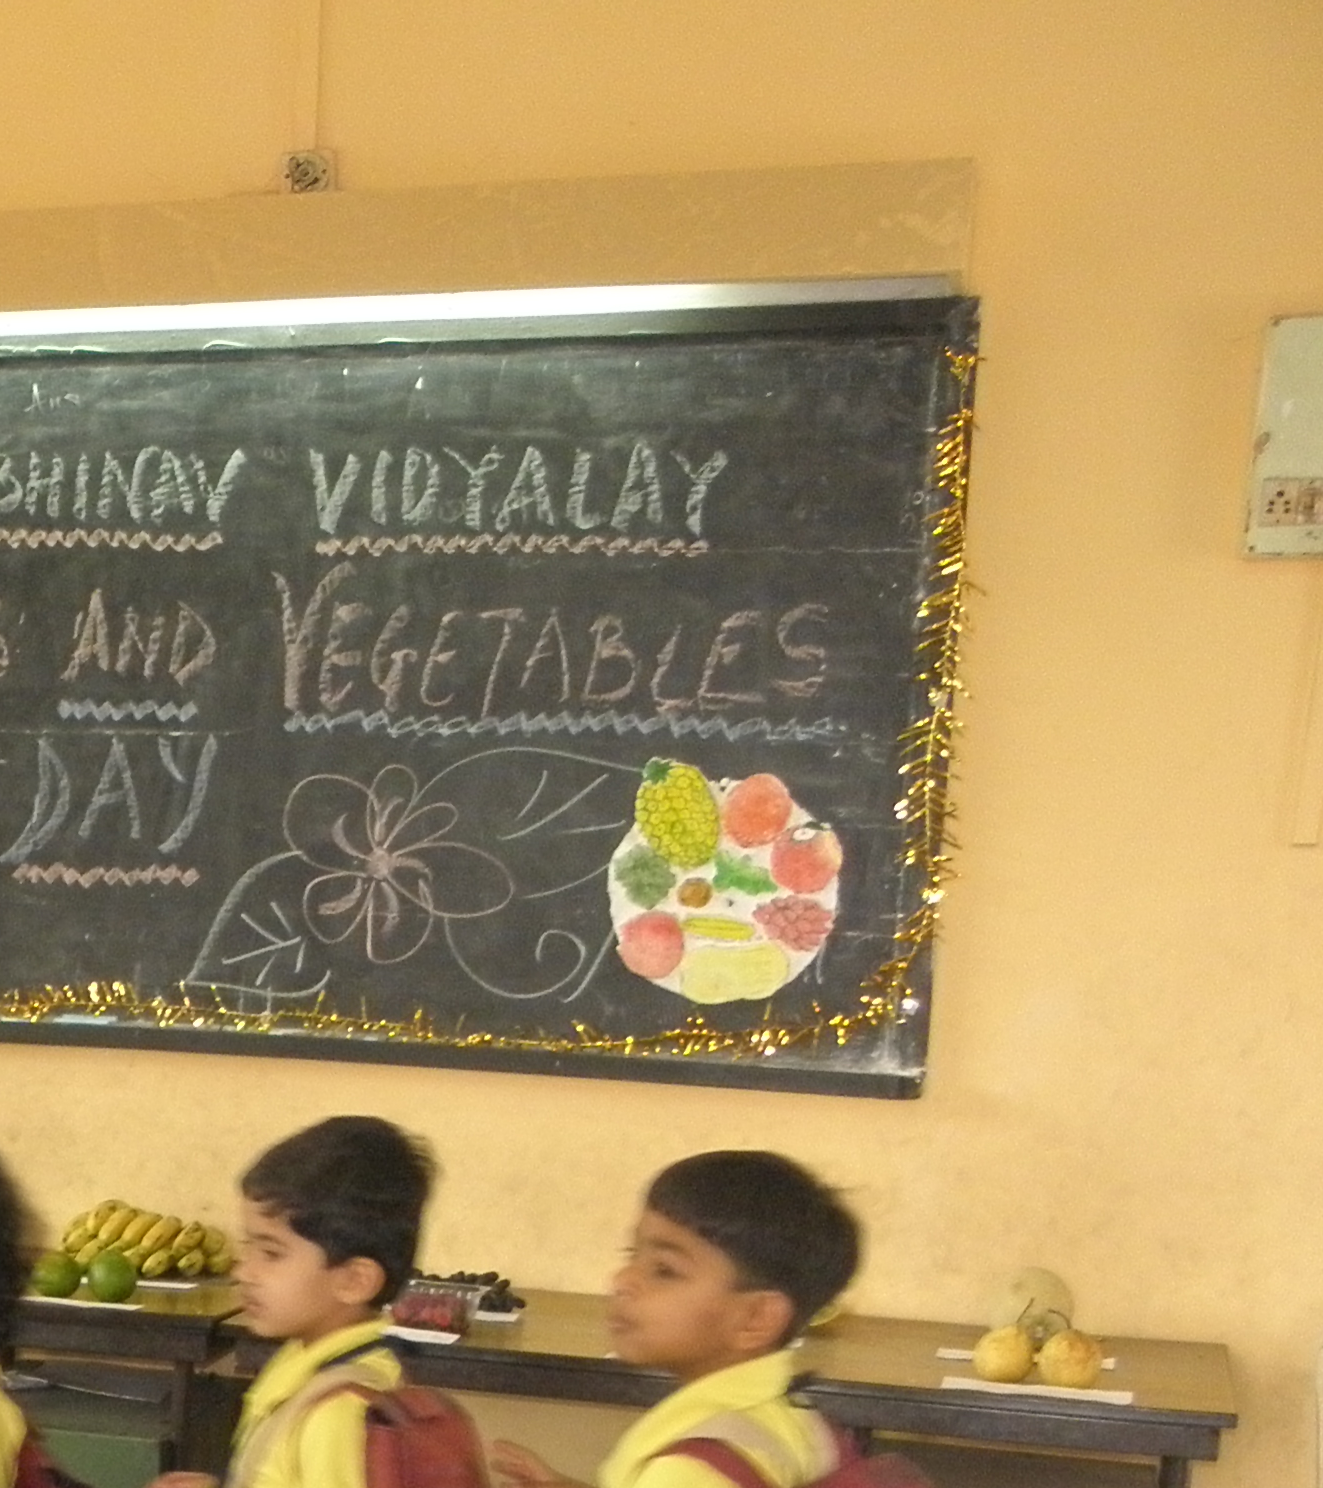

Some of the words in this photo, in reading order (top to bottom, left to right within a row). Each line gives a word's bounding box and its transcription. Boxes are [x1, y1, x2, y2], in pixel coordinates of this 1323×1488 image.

[307, 442, 729, 536] VIDYALAY
[59, 587, 217, 687] AND
[271, 562, 829, 717] VEGETABLES
